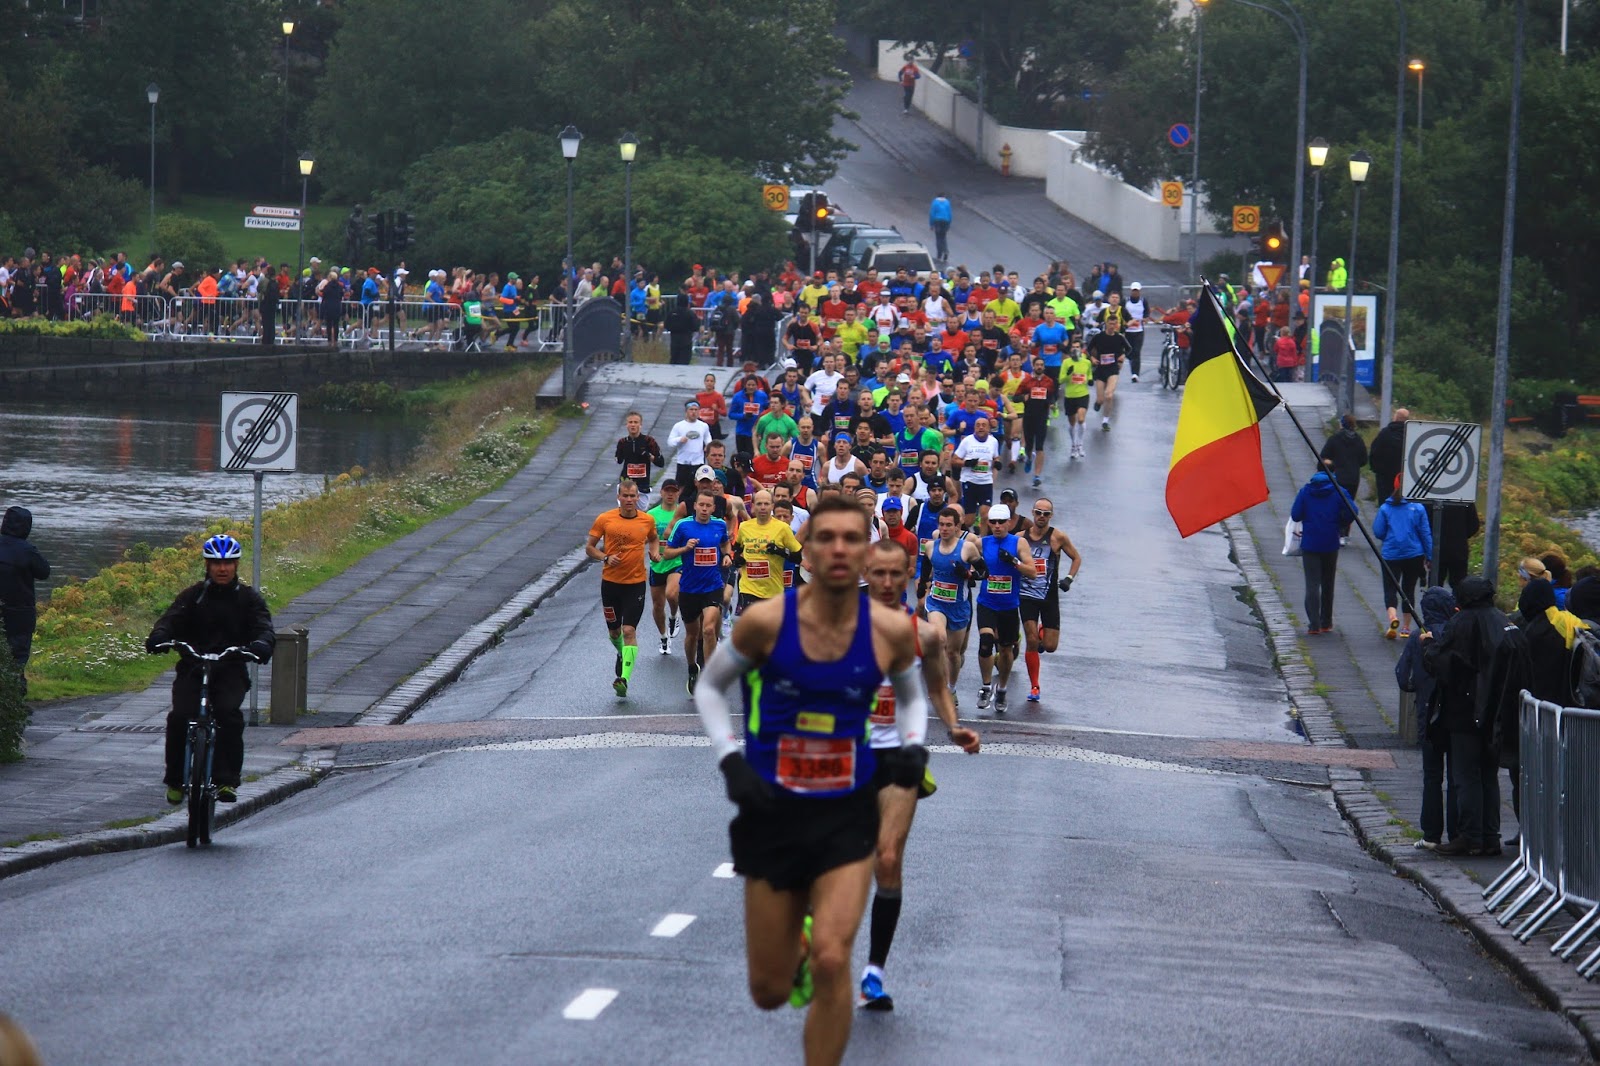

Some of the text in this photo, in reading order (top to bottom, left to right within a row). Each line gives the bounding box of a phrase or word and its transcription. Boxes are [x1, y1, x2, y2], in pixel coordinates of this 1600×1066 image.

[768, 192, 784, 203] 30
[1166, 190, 1179, 198] 30
[1238, 213, 1255, 224] 30
[237, 418, 281, 445] 30
[1419, 448, 1463, 475] 30
[937, 588, 951, 598] 263
